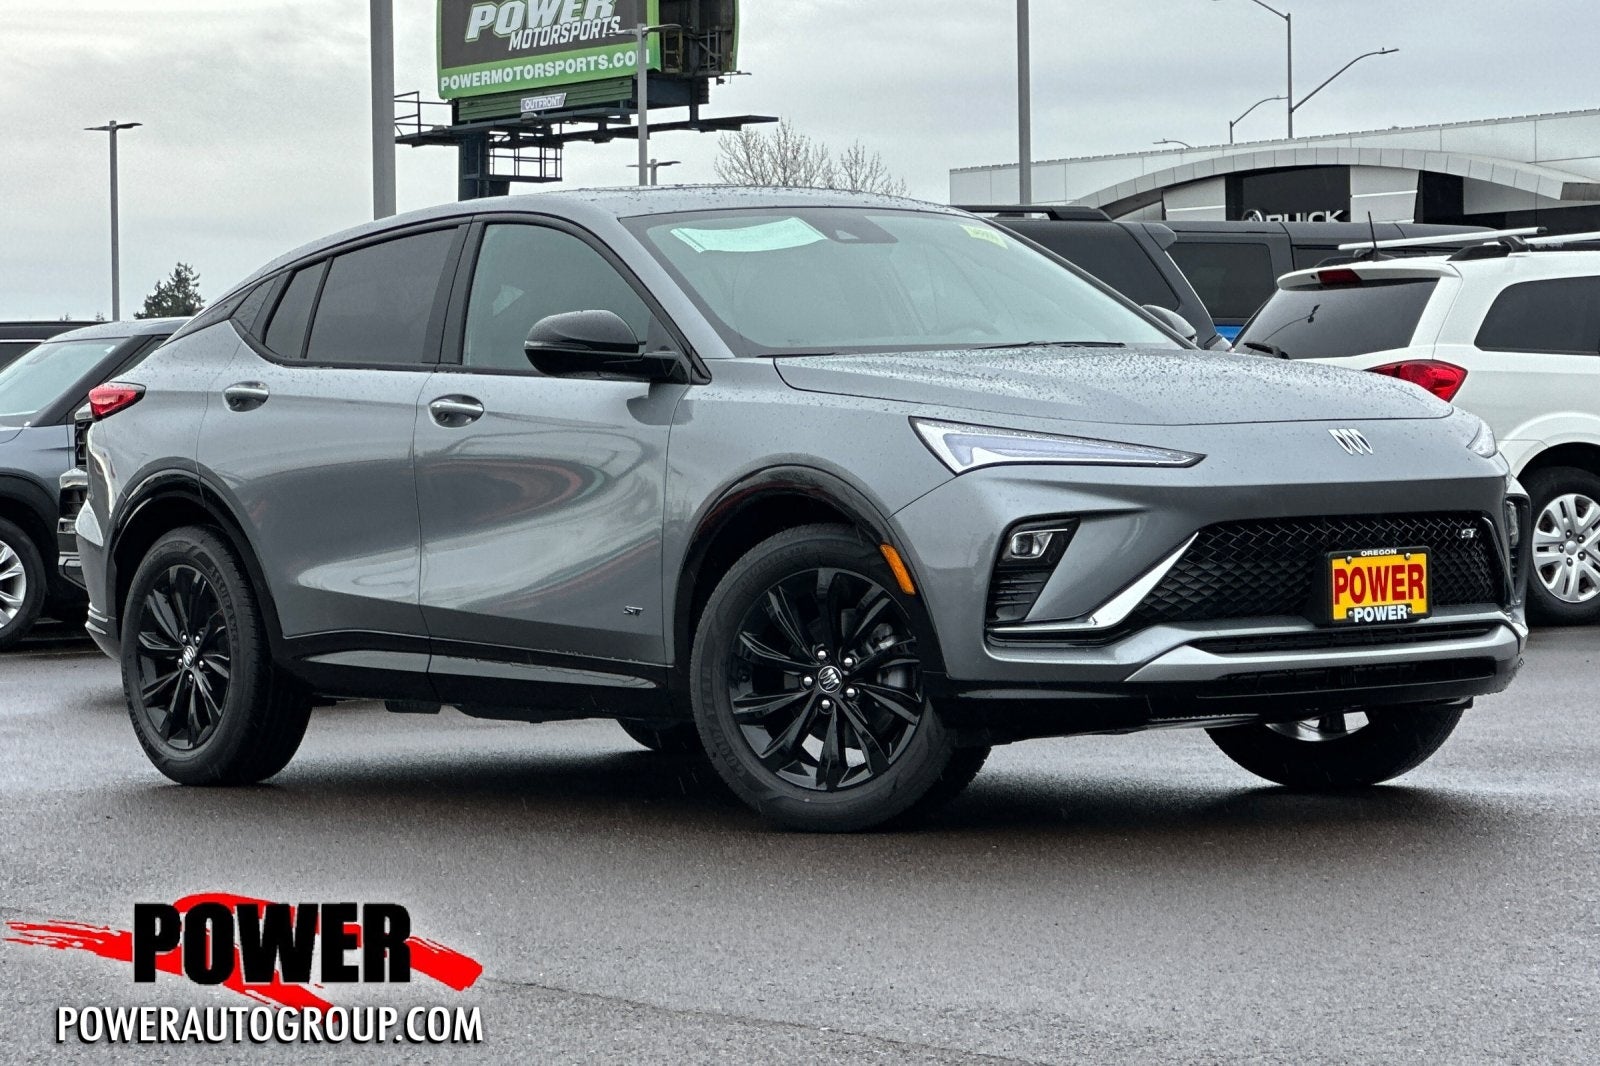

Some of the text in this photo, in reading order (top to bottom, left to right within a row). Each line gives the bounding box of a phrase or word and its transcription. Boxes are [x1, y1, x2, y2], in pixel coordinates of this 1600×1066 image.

[509, 16, 621, 51] MOTORSPORTS
[524, 96, 562, 109] OUTFRONT
[1361, 549, 1397, 557] OREGON
[1334, 563, 1425, 605] POWER
[1354, 605, 1408, 623] POWER
